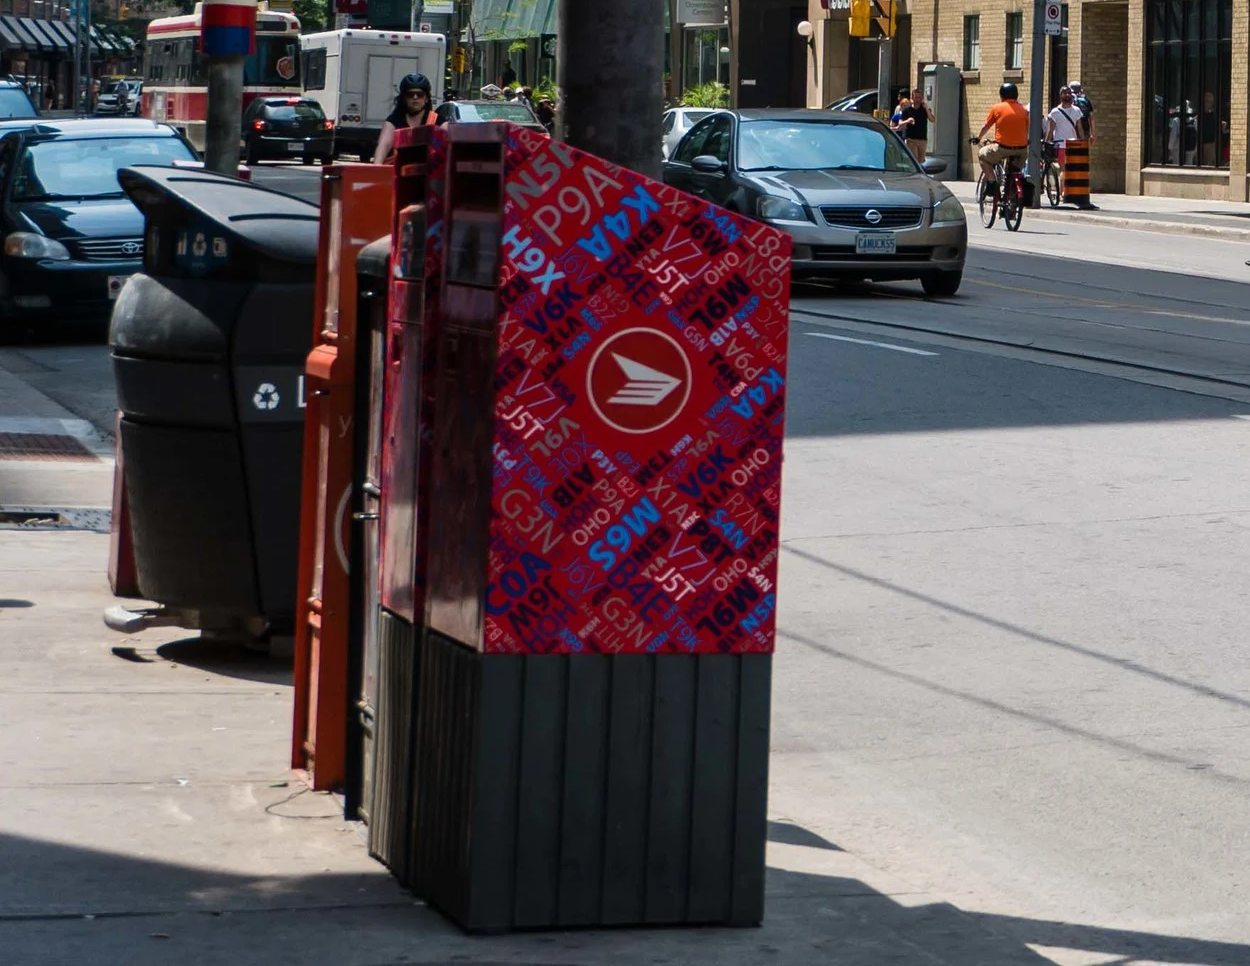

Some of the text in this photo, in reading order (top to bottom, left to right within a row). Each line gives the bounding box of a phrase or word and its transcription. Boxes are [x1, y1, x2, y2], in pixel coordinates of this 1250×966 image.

[532, 165, 623, 247] P9A
[576, 185, 660, 261] K4A
[702, 205, 741, 242] S4N
[626, 220, 664, 256] E3N
[662, 225, 711, 279] V7J
[680, 214, 729, 256] J6W
[743, 226, 790, 275] P8T
[501, 224, 565, 295] H9X
[551, 244, 600, 286] J6V
[605, 252, 657, 306] B4E
[648, 260, 689, 292] J5T
[738, 253, 783, 299] G5N
[524, 282, 583, 334] V6K
[688, 273, 751, 329] M9L
[499, 315, 536, 359] X1A
[684, 326, 708, 351] G5N
[710, 317, 737, 345] A1B
[726, 338, 763, 380] P9A
[515, 369, 565, 424] V7J
[730, 367, 785, 419] K4A
[502, 406, 544, 439] J5T
[529, 417, 580, 456] V9L
[685, 430, 720, 457] V9L
[515, 453, 552, 496] T9K
[552, 463, 594, 507] A1B
[677, 446, 734, 497] V6K
[593, 478, 624, 514] P9A
[647, 477, 688, 525] X1A
[725, 493, 768, 535] R7N
[500, 488, 564, 554] G3N
[588, 497, 660, 570] M6S
[687, 519, 735, 564] P8T
[709, 509, 748, 549] S4N
[633, 526, 670, 563] E3N
[668, 531, 717, 586] V7J
[559, 556, 608, 598] J6V
[607, 557, 673, 623] B4E
[655, 567, 695, 600] J5T
[748, 567, 772, 591] S4N
[507, 575, 560, 634] J6W
[603, 597, 652, 647] G3N
[695, 578, 759, 636] M9L
[740, 593, 775, 632] N5P
[670, 616, 700, 654] T9K
